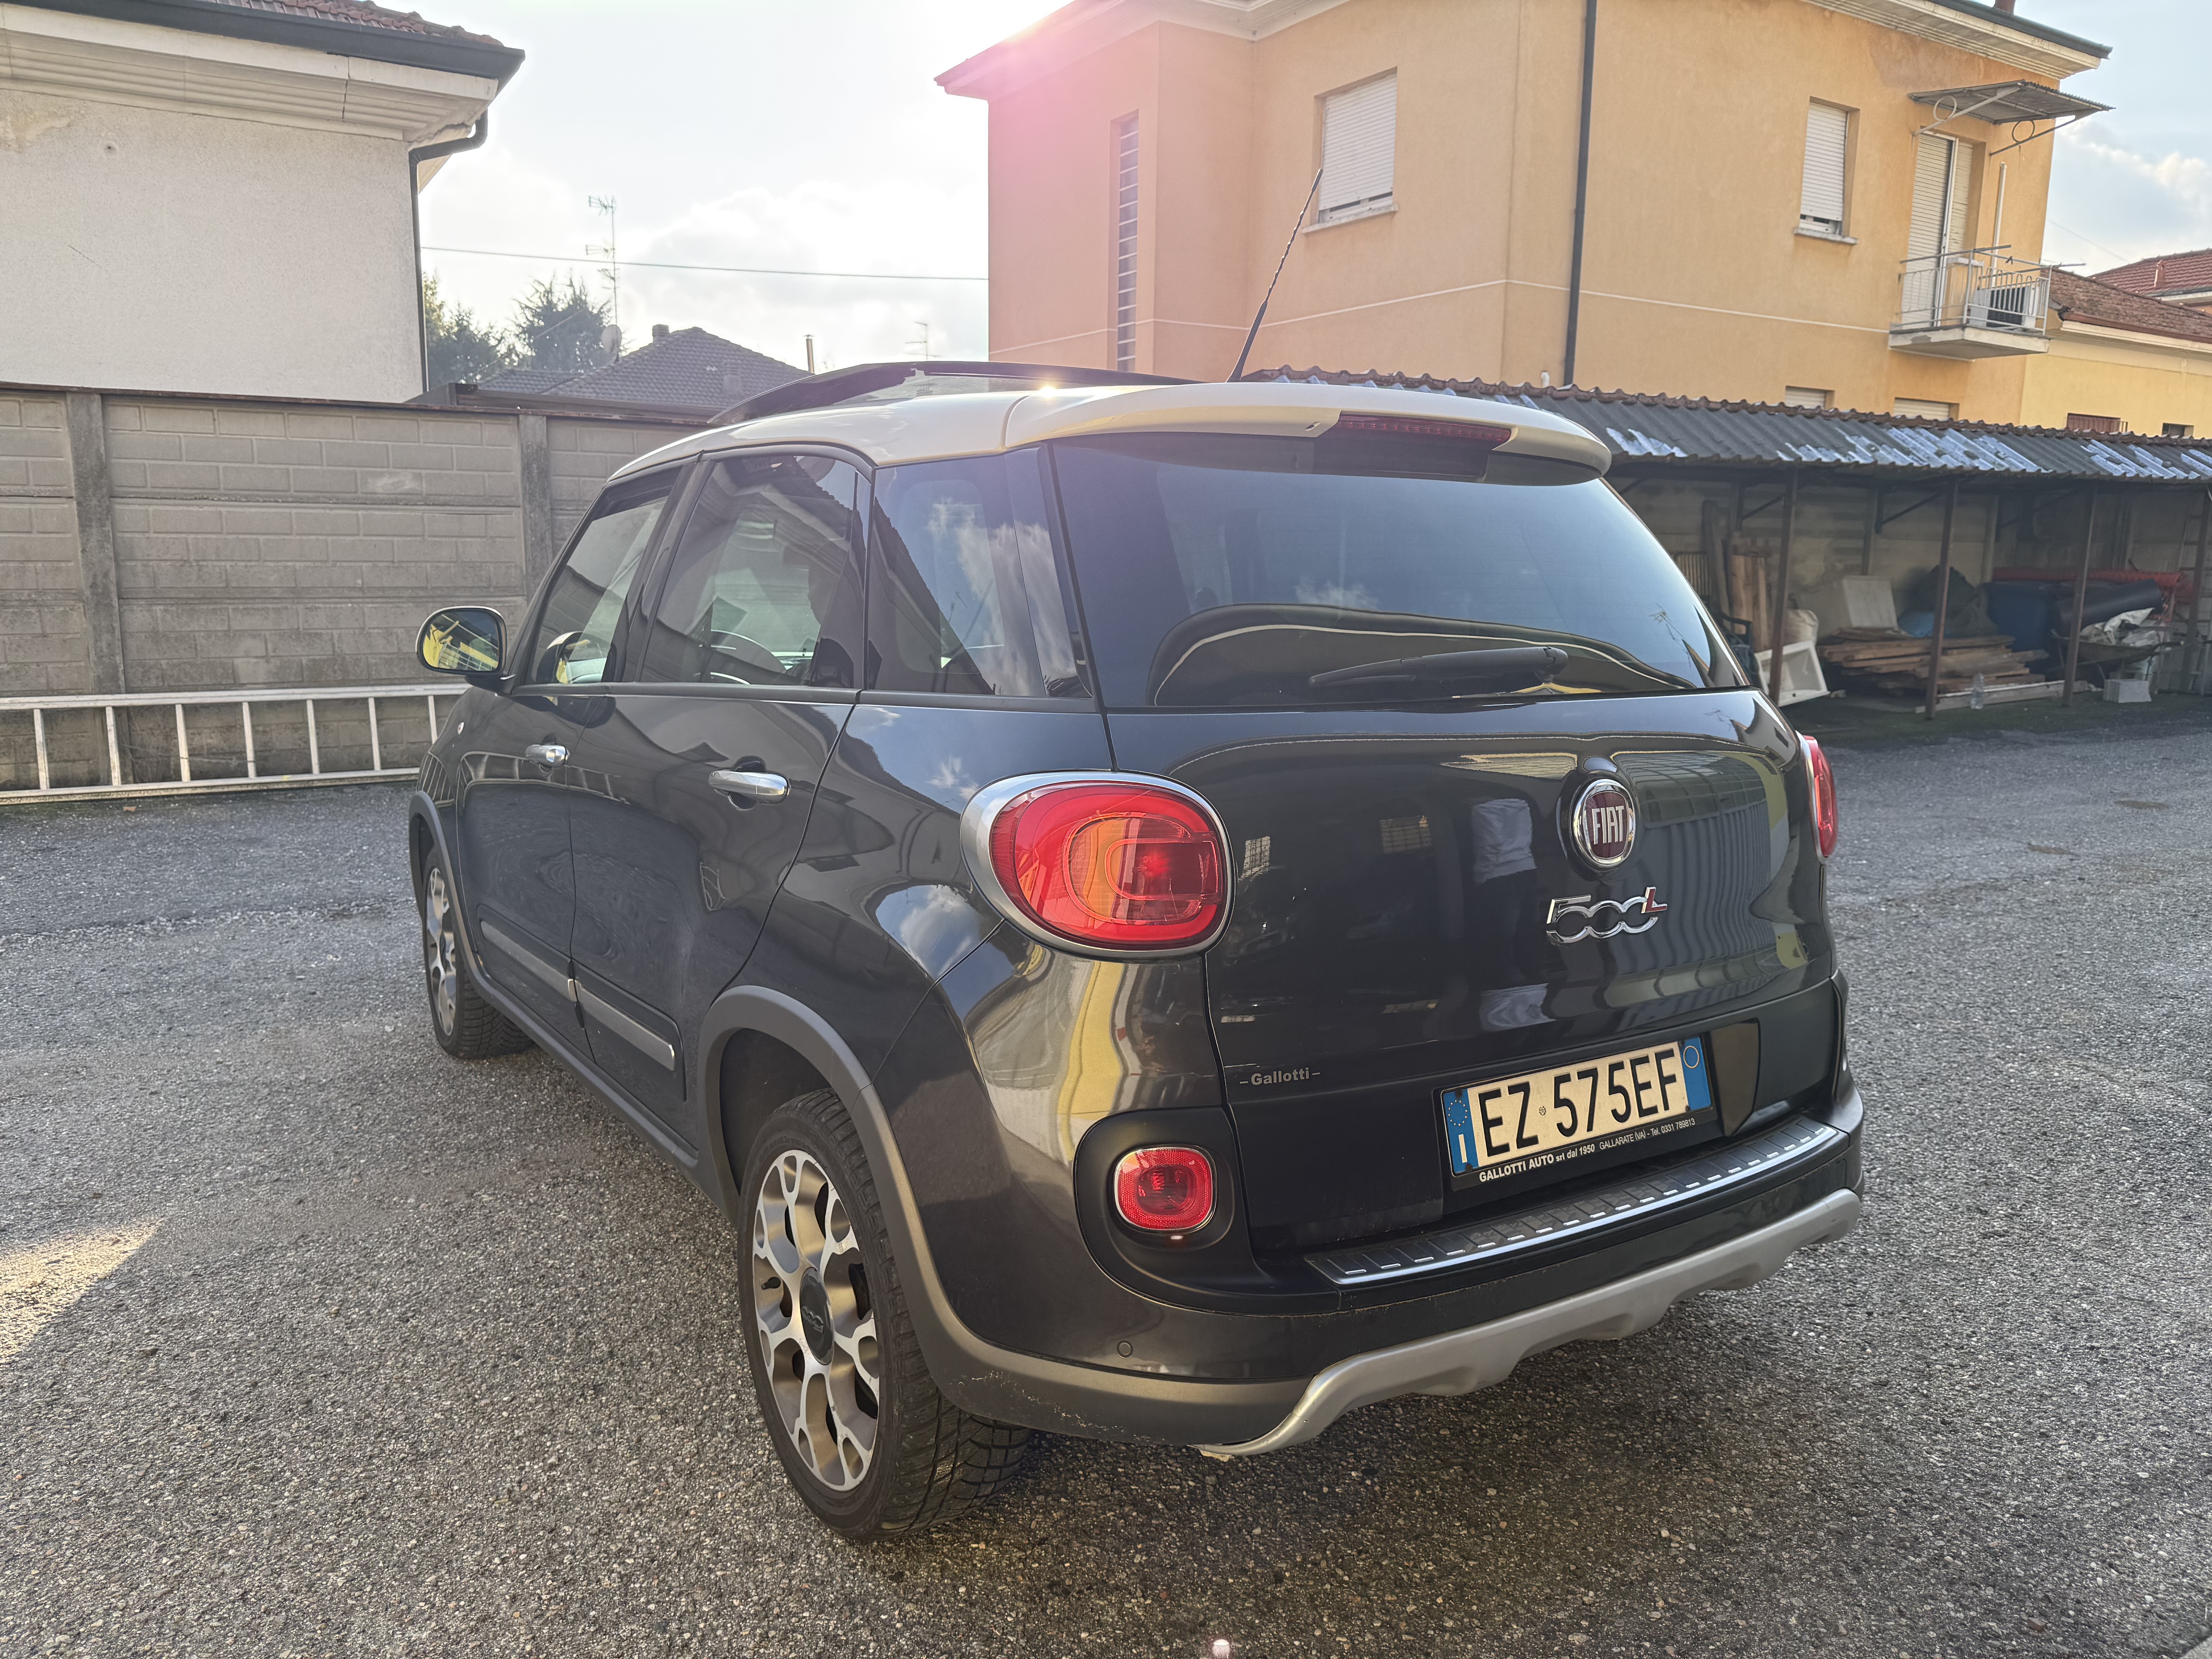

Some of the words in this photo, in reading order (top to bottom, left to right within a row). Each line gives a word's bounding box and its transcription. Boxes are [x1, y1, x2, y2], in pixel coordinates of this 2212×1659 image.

[1592, 805, 1624, 845] FIAT
[1458, 1134, 1467, 1163] I
[1478, 1081, 1539, 1157] EZ
[1554, 1049, 1677, 1137] 575EF
[1479, 1161, 1527, 1182] GALLOTTI
[1529, 1154, 1554, 1169] AUTO
[1556, 1152, 1565, 1162] srl
[1567, 1148, 1577, 1159] dal
[1579, 1144, 1595, 1156] 1950
[1599, 1134, 1634, 1150] GALLARATE
[1635, 1129, 1646, 1140] (VA)
[1650, 1127, 1661, 1136] Tel.
[1661, 1123, 1674, 1133] 0331
[1675, 1118, 1695, 1130] 789813
